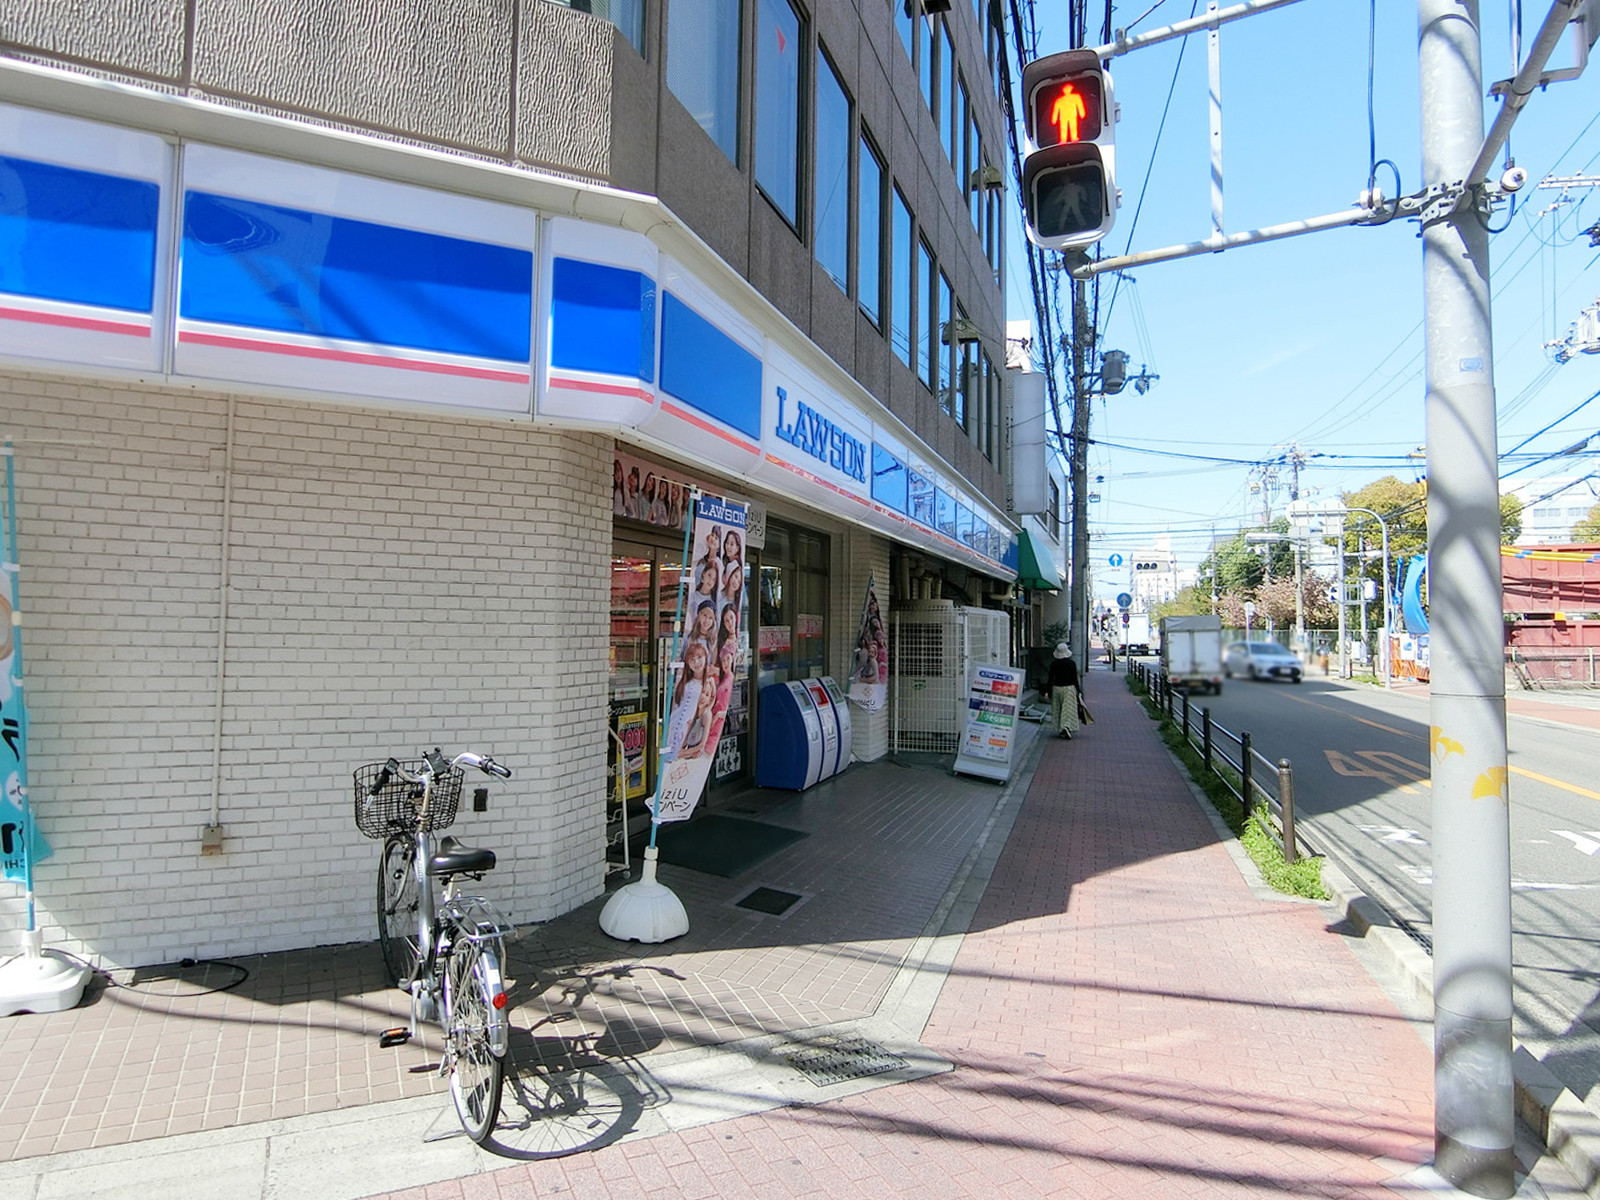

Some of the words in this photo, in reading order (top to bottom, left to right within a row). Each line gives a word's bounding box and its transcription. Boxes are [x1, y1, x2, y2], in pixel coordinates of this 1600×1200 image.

[776, 386, 865, 483] LAWSON
[699, 502, 746, 526] LAWSON
[660, 788, 689, 800] iziU
[648, 801, 691, 813] ンペーン
